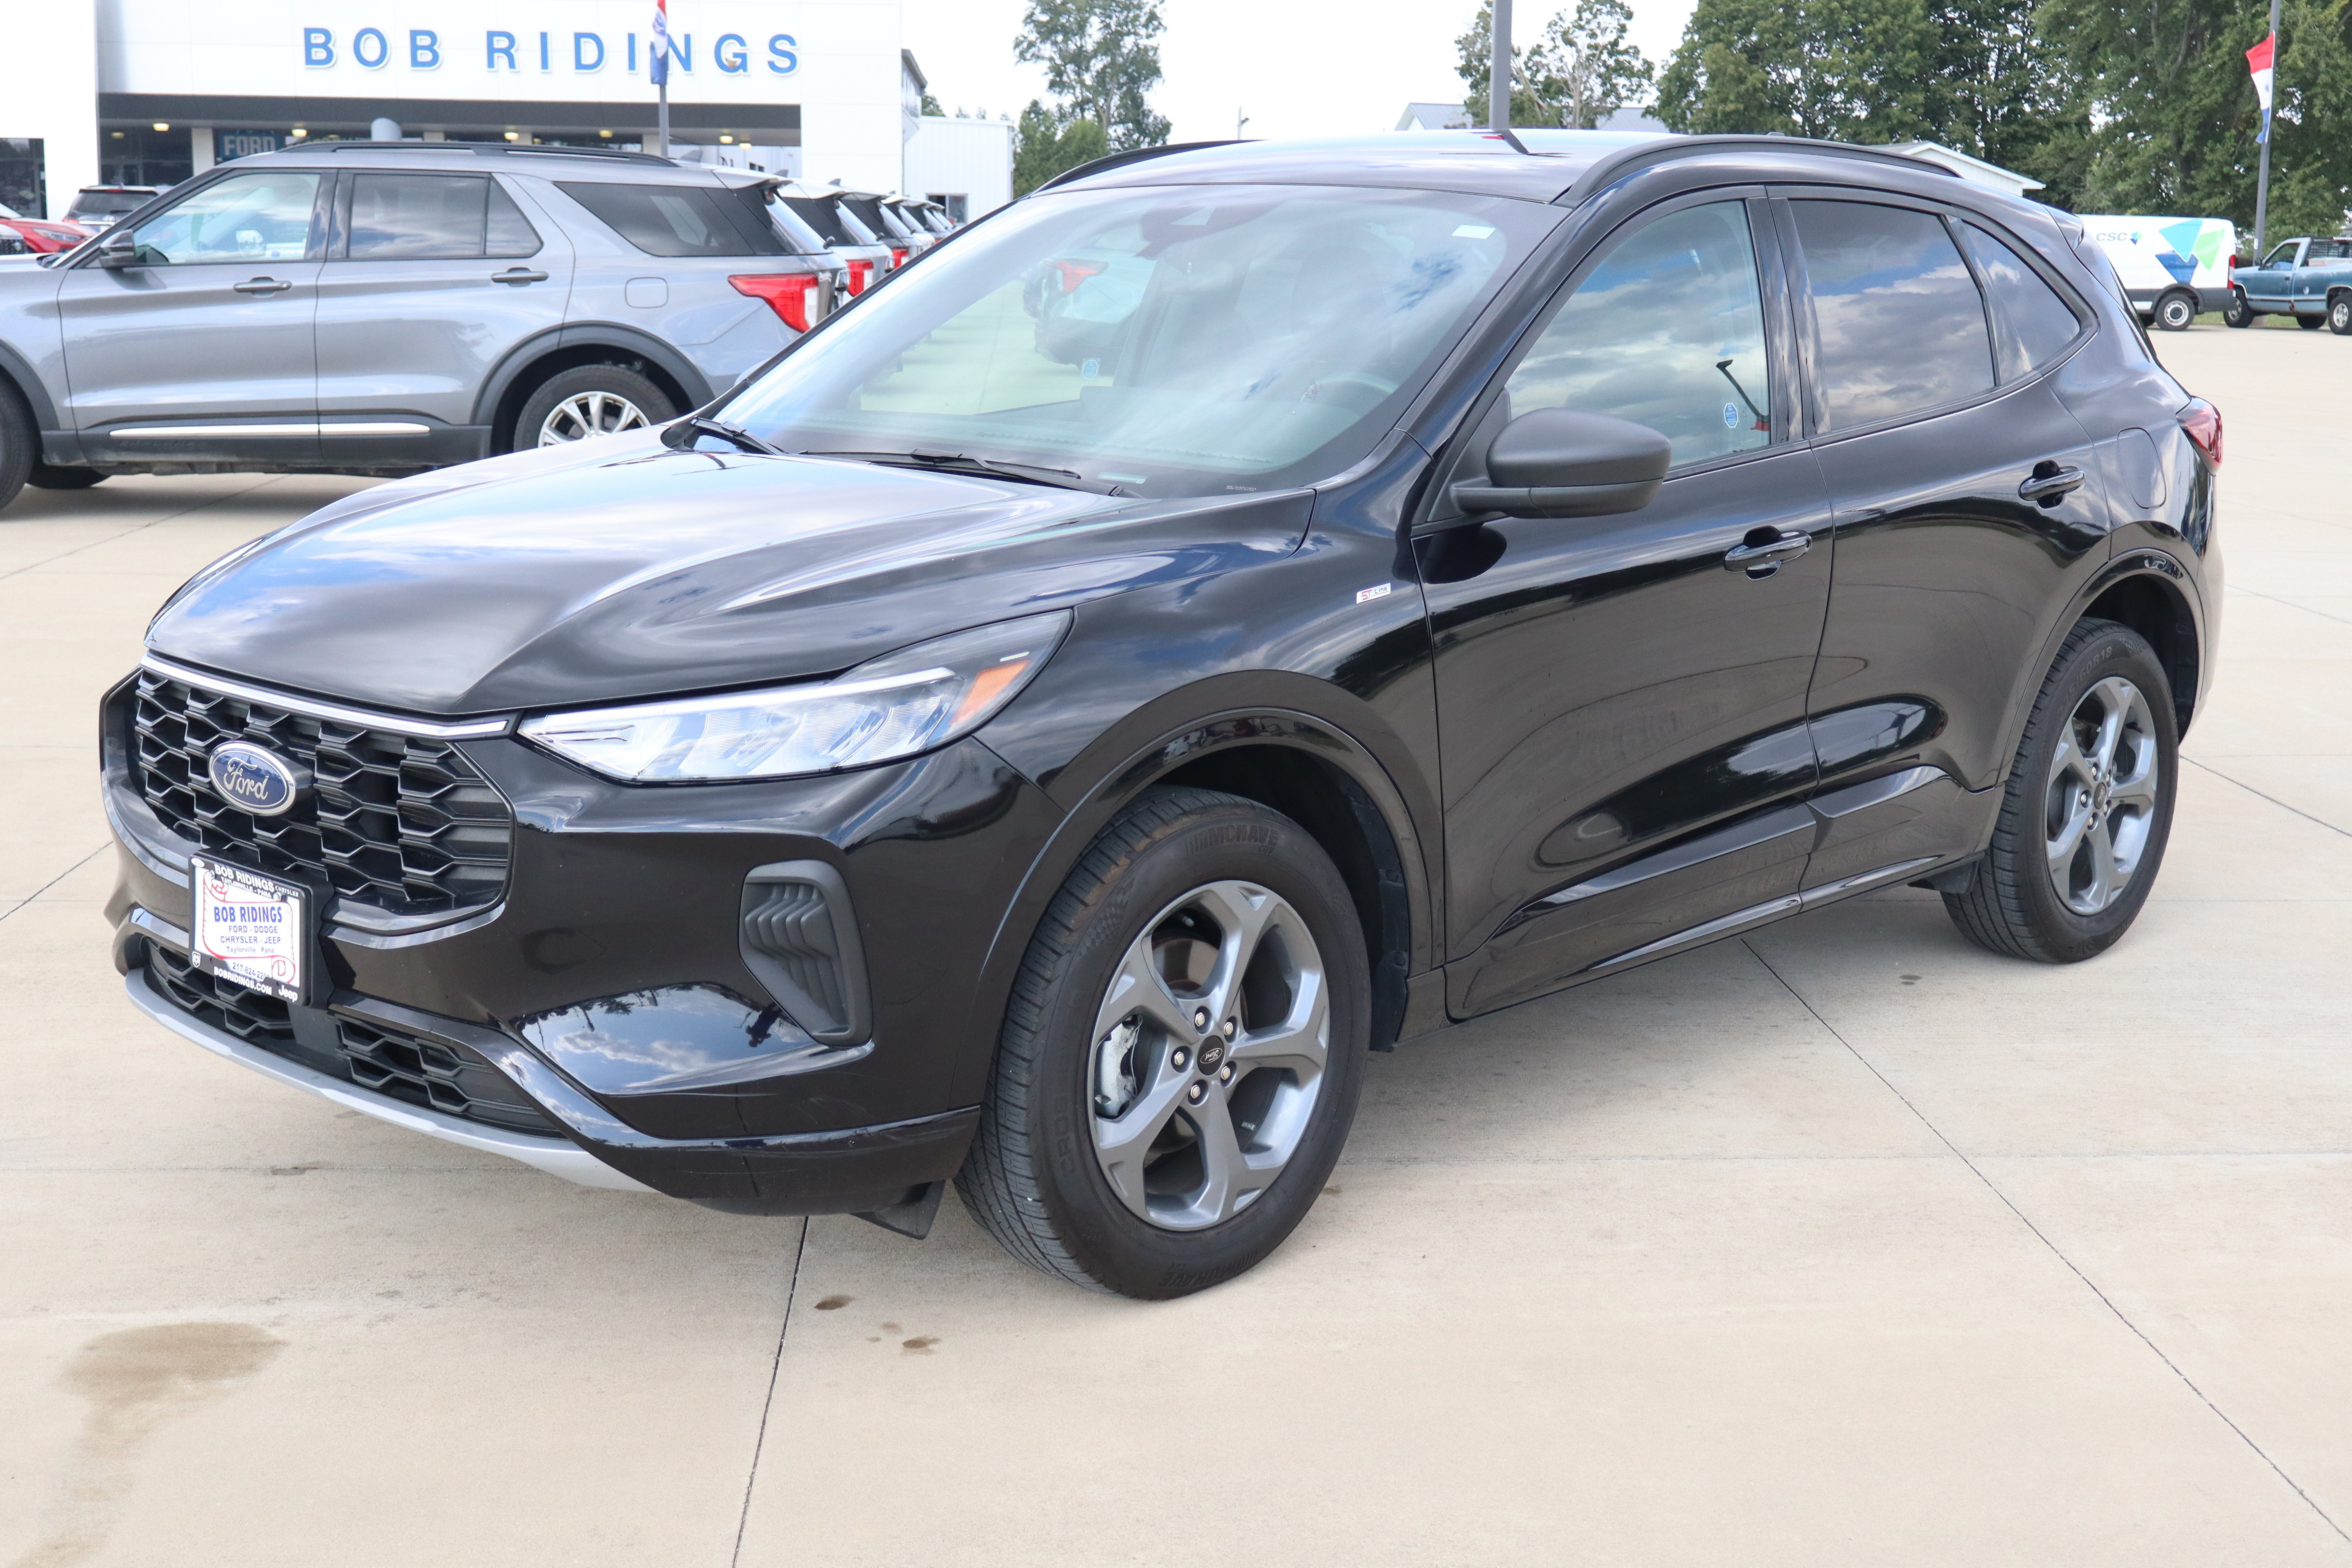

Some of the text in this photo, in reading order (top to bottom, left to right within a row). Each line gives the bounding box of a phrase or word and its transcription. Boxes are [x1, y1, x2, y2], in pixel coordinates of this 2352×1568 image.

[303, 27, 799, 74] BOB RIDINGS
[224, 135, 276, 156] FORD
[2096, 232, 2127, 241] CSC
[1361, 589, 1372, 601] ST
[223, 757, 270, 800] Ford
[1208, 824, 1278, 847] MOHAVE
[214, 864, 275, 893] BOB RIDINGS
[220, 876, 254, 892] TAYLORVILLE
[257, 889, 272, 898] PANA
[275, 885, 299, 898] CHRYSLER
[214, 906, 282, 923] BOB RIDINGS
[254, 925, 278, 933] DODGE
[214, 966, 272, 996] BOBRIDINGS.COM
[278, 984, 298, 1002] Jeep
[1205, 1049, 1219, 1061] Ford
